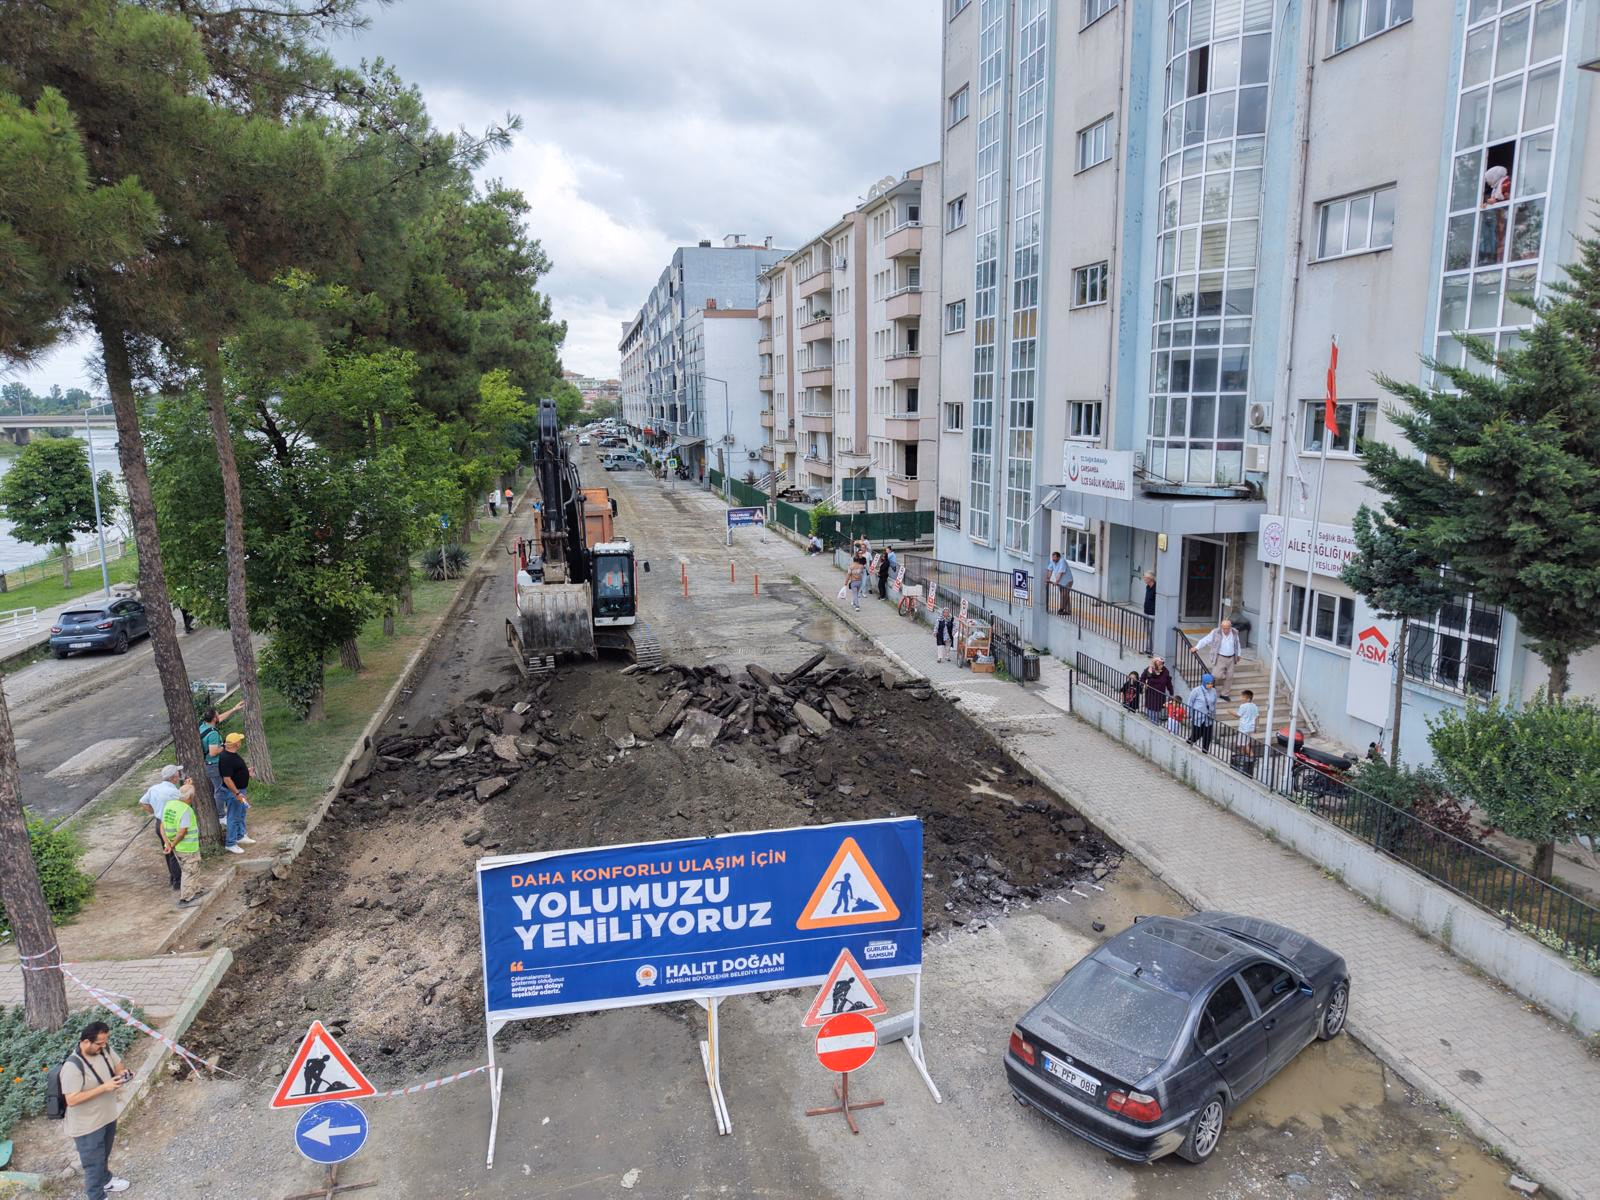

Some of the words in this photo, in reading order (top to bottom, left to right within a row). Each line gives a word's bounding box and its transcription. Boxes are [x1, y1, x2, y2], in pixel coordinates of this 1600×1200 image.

[1288, 538, 1306, 552] AİLE
[1308, 543, 1341, 559] SAĞLIĞI
[1318, 532, 1335, 541] Sağlık
[1337, 535, 1356, 544] Bakan
[1016, 572, 1023, 586] P
[1356, 642, 1386, 663] ASM
[511, 872, 565, 888] DAHA
[571, 861, 672, 883] KONFORLU
[678, 854, 745, 873] ULAŞIM
[751, 849, 787, 867] İÇİN
[512, 876, 730, 920] YOLUMUZU
[514, 901, 772, 950] YENİLİYORUZ
[722, 952, 785, 972] DOĞAN
[730, 969, 758, 978] BELEDİYE
[759, 966, 784, 975] BAŞKANI
[1050, 1061, 1058, 1074] 34
[1062, 1068, 1076, 1083] PFP
